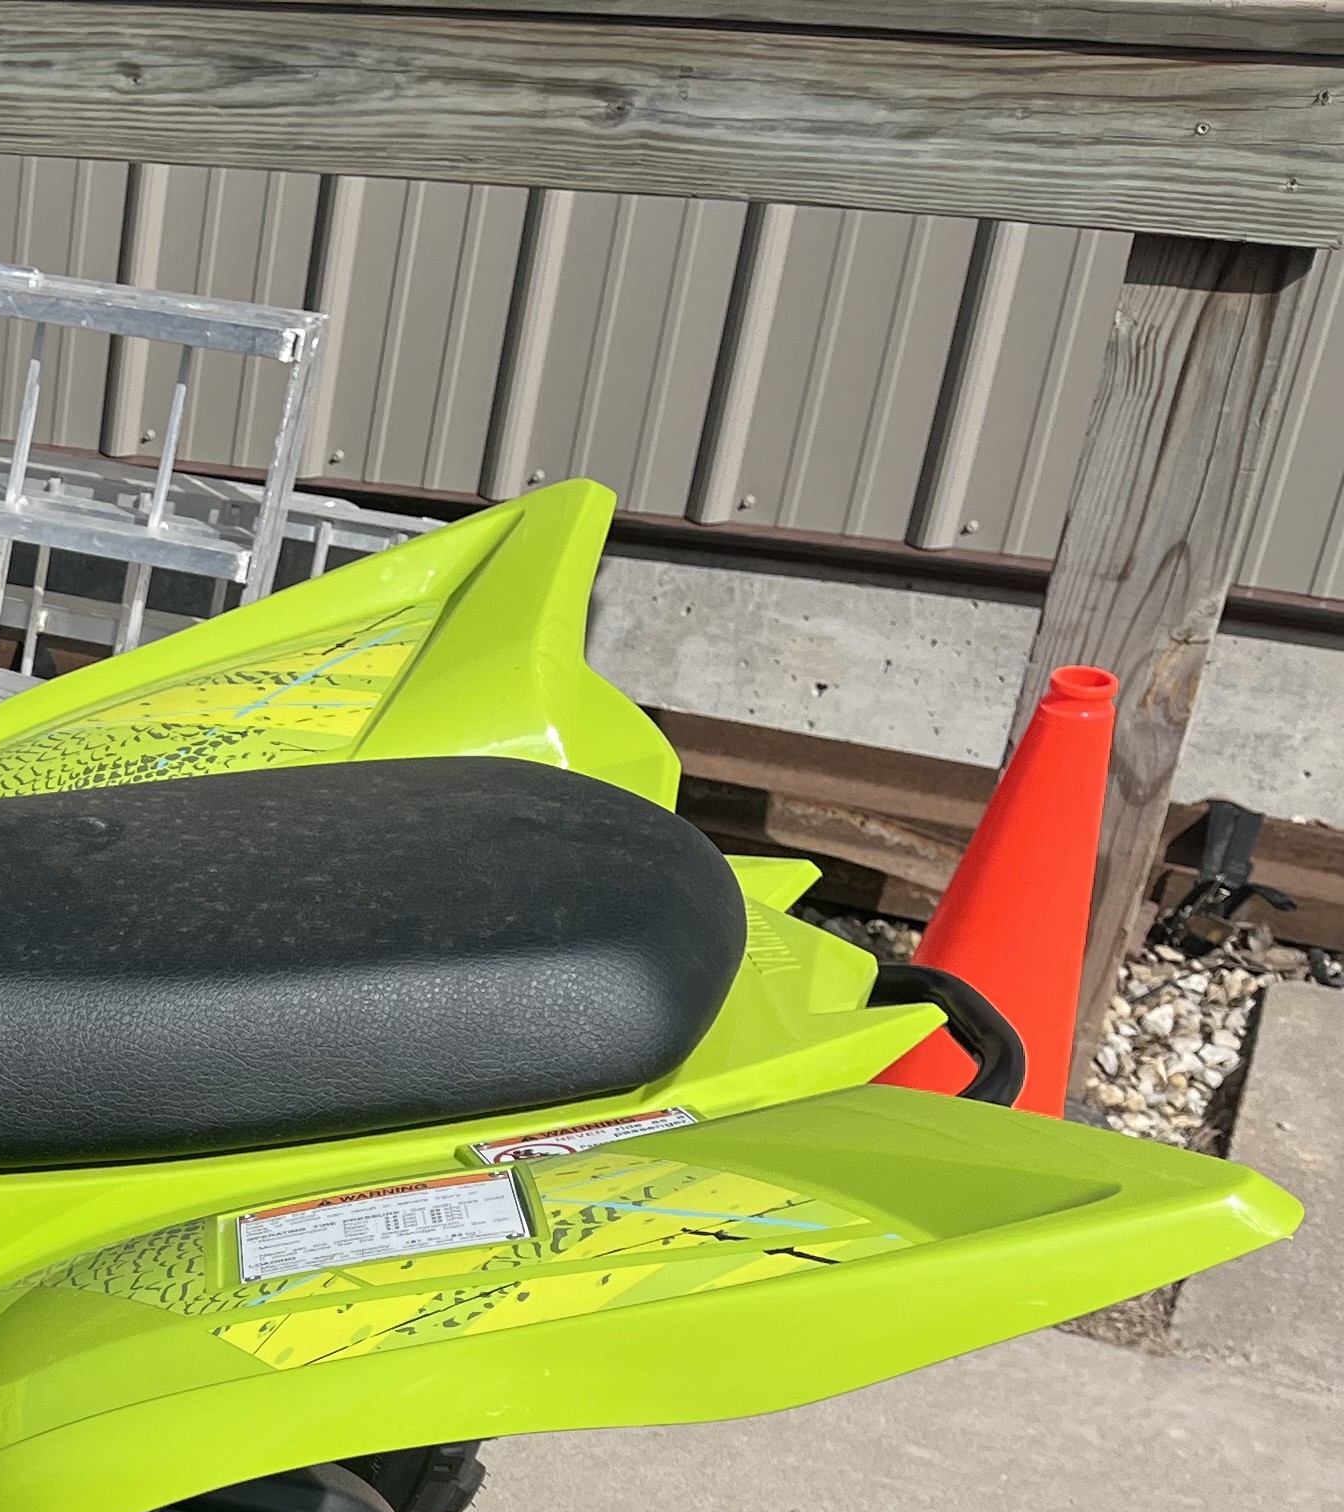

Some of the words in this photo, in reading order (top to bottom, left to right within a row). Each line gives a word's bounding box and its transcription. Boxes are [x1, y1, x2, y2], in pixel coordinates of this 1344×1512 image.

[542, 1117, 636, 1139] WARNING
[555, 1129, 606, 1142] NEVER
[339, 1183, 429, 1204] WARNING
